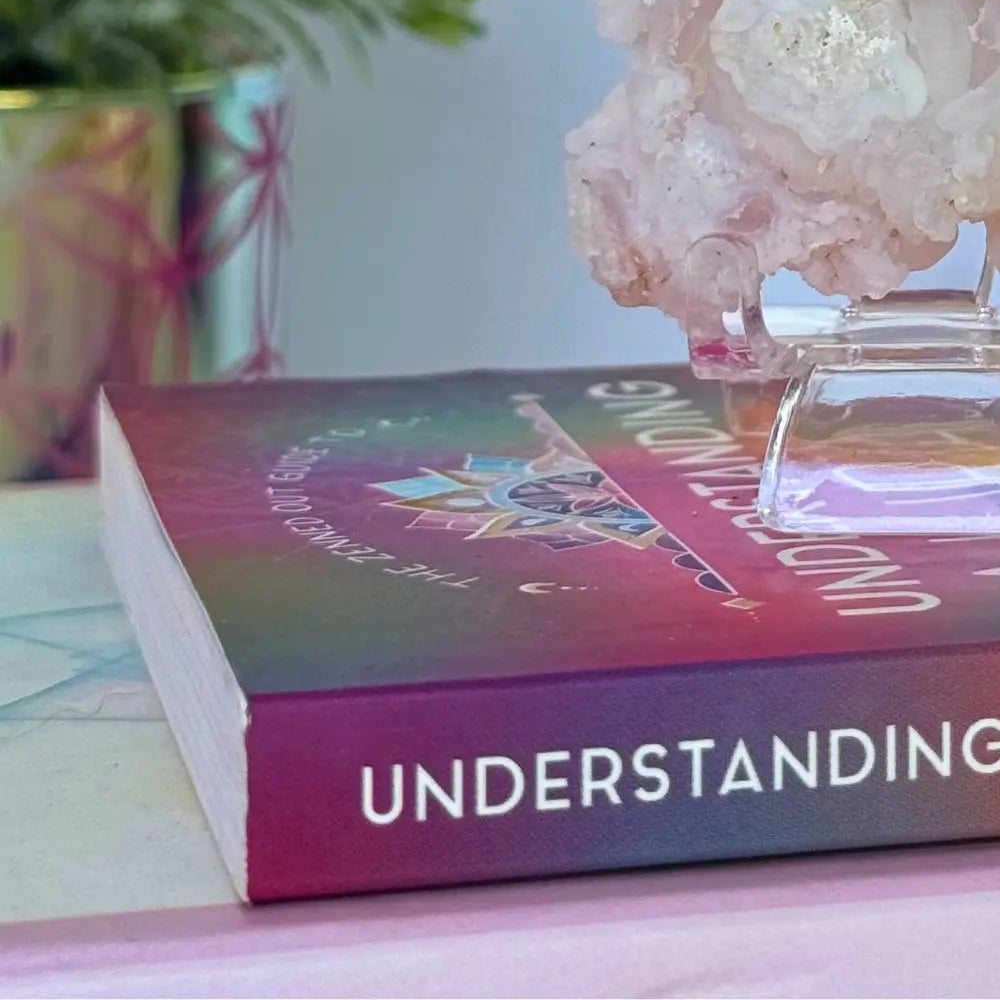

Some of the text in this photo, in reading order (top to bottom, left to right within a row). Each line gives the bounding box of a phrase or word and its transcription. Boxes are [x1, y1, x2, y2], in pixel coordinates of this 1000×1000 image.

[268, 446, 331, 482] GUIDE
[267, 486, 312, 512] OUT
[587, 380, 941, 616] UNDETANDING
[285, 516, 396, 563] ZENNED
[381, 563, 479, 588] THE
